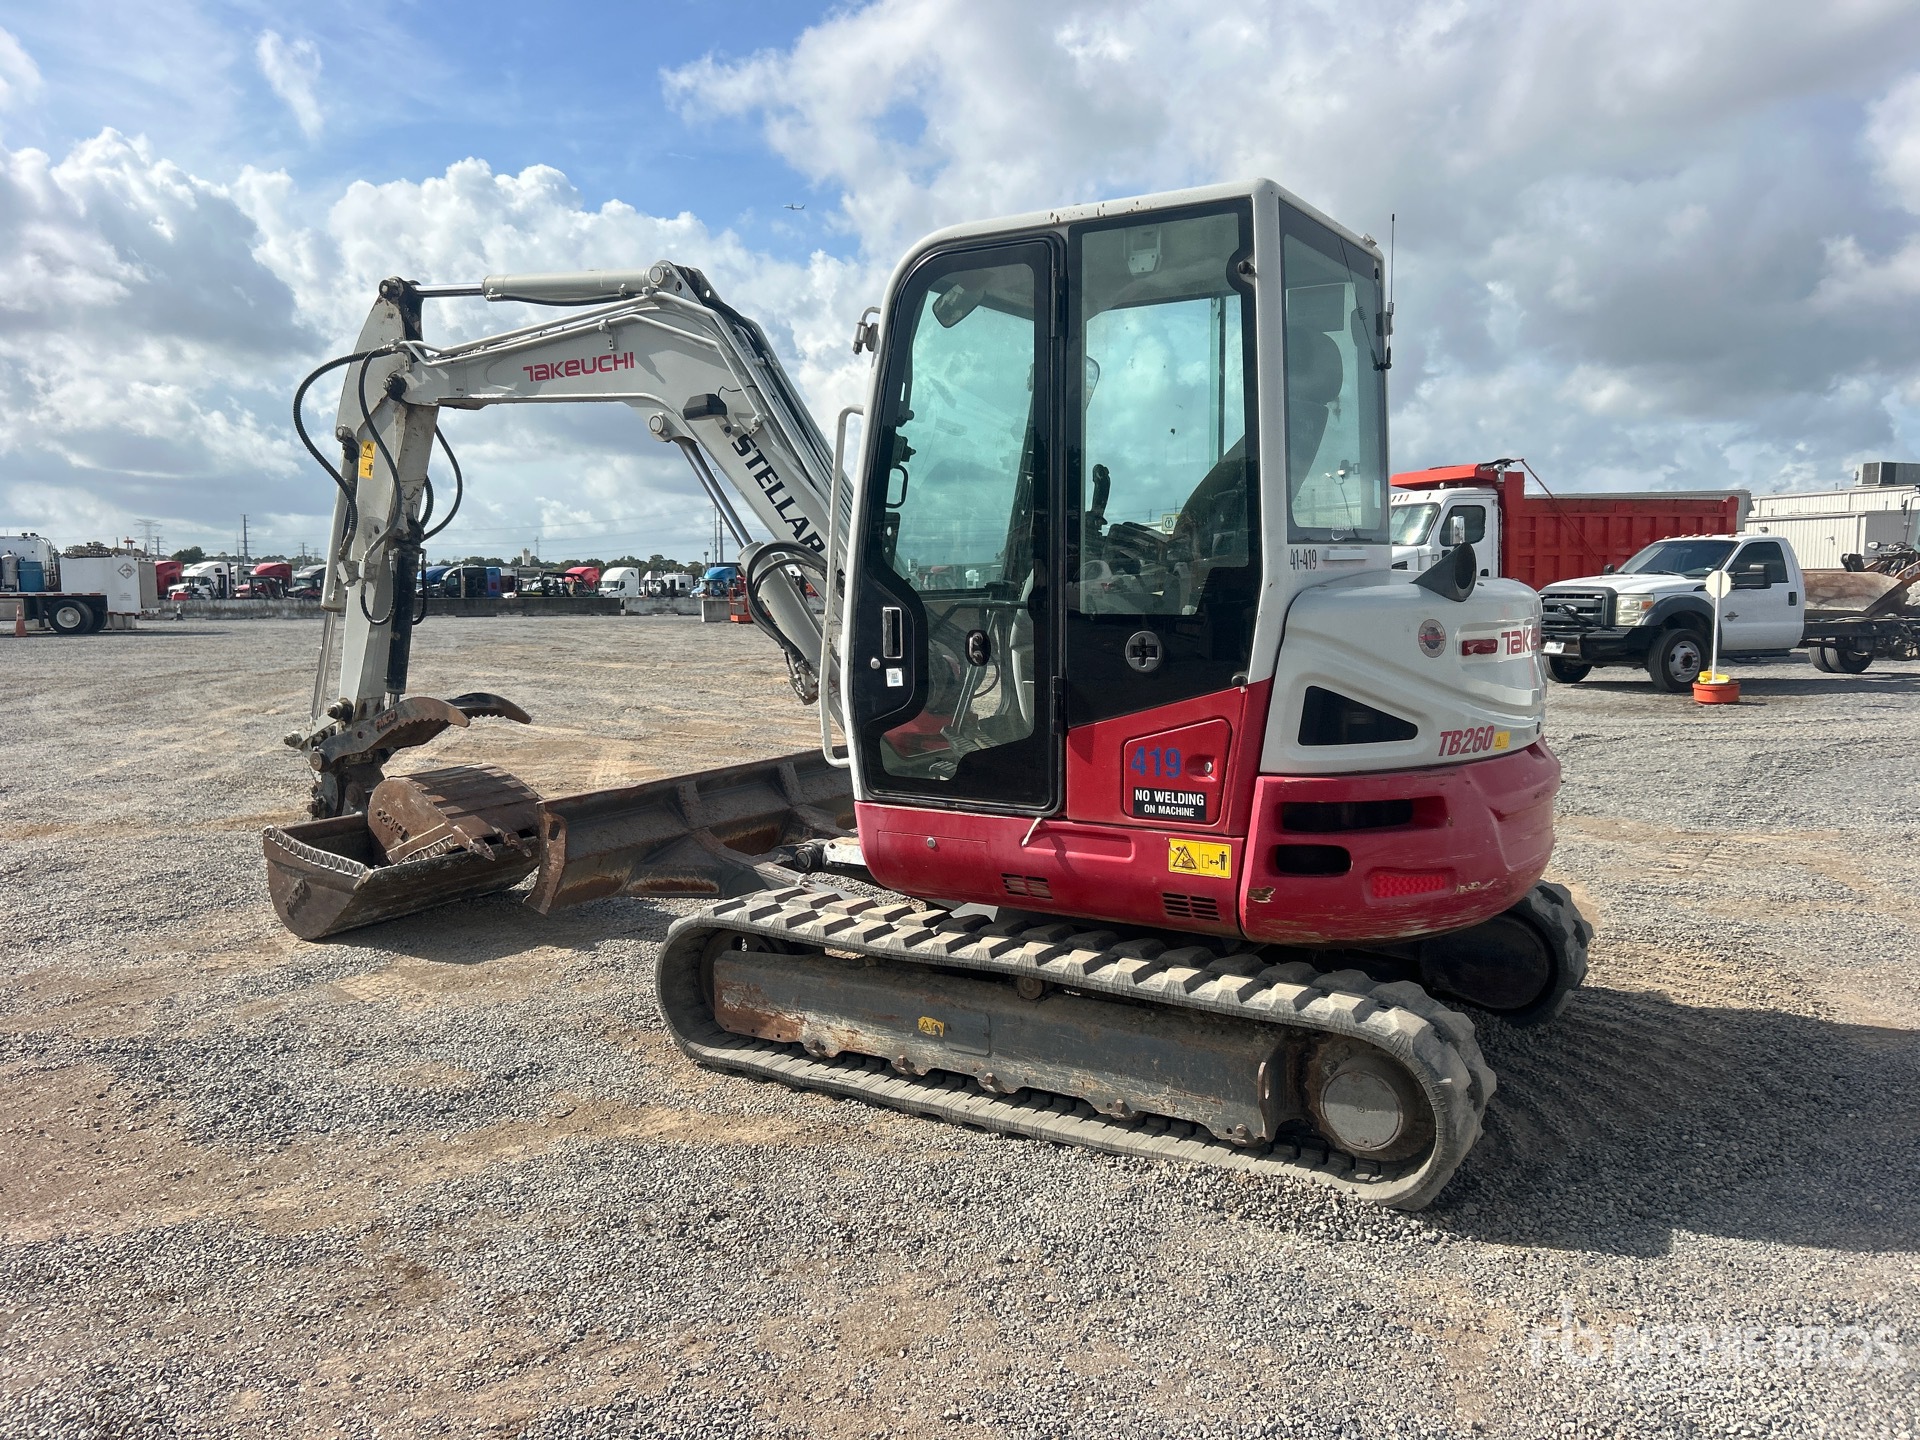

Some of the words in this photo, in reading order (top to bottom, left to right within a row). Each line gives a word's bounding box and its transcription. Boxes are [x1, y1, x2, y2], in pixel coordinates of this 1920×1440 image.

[523, 352, 635, 382] TAKEUCHI
[1290, 548, 1317, 570] 41-419
[1438, 725, 1494, 756] TB260
[1131, 746, 1181, 778] 419
[1135, 789, 1150, 801] NO
[1154, 790, 1205, 806] WELDING
[1144, 804, 1156, 814] ON
[1158, 805, 1195, 817] MACHINE
